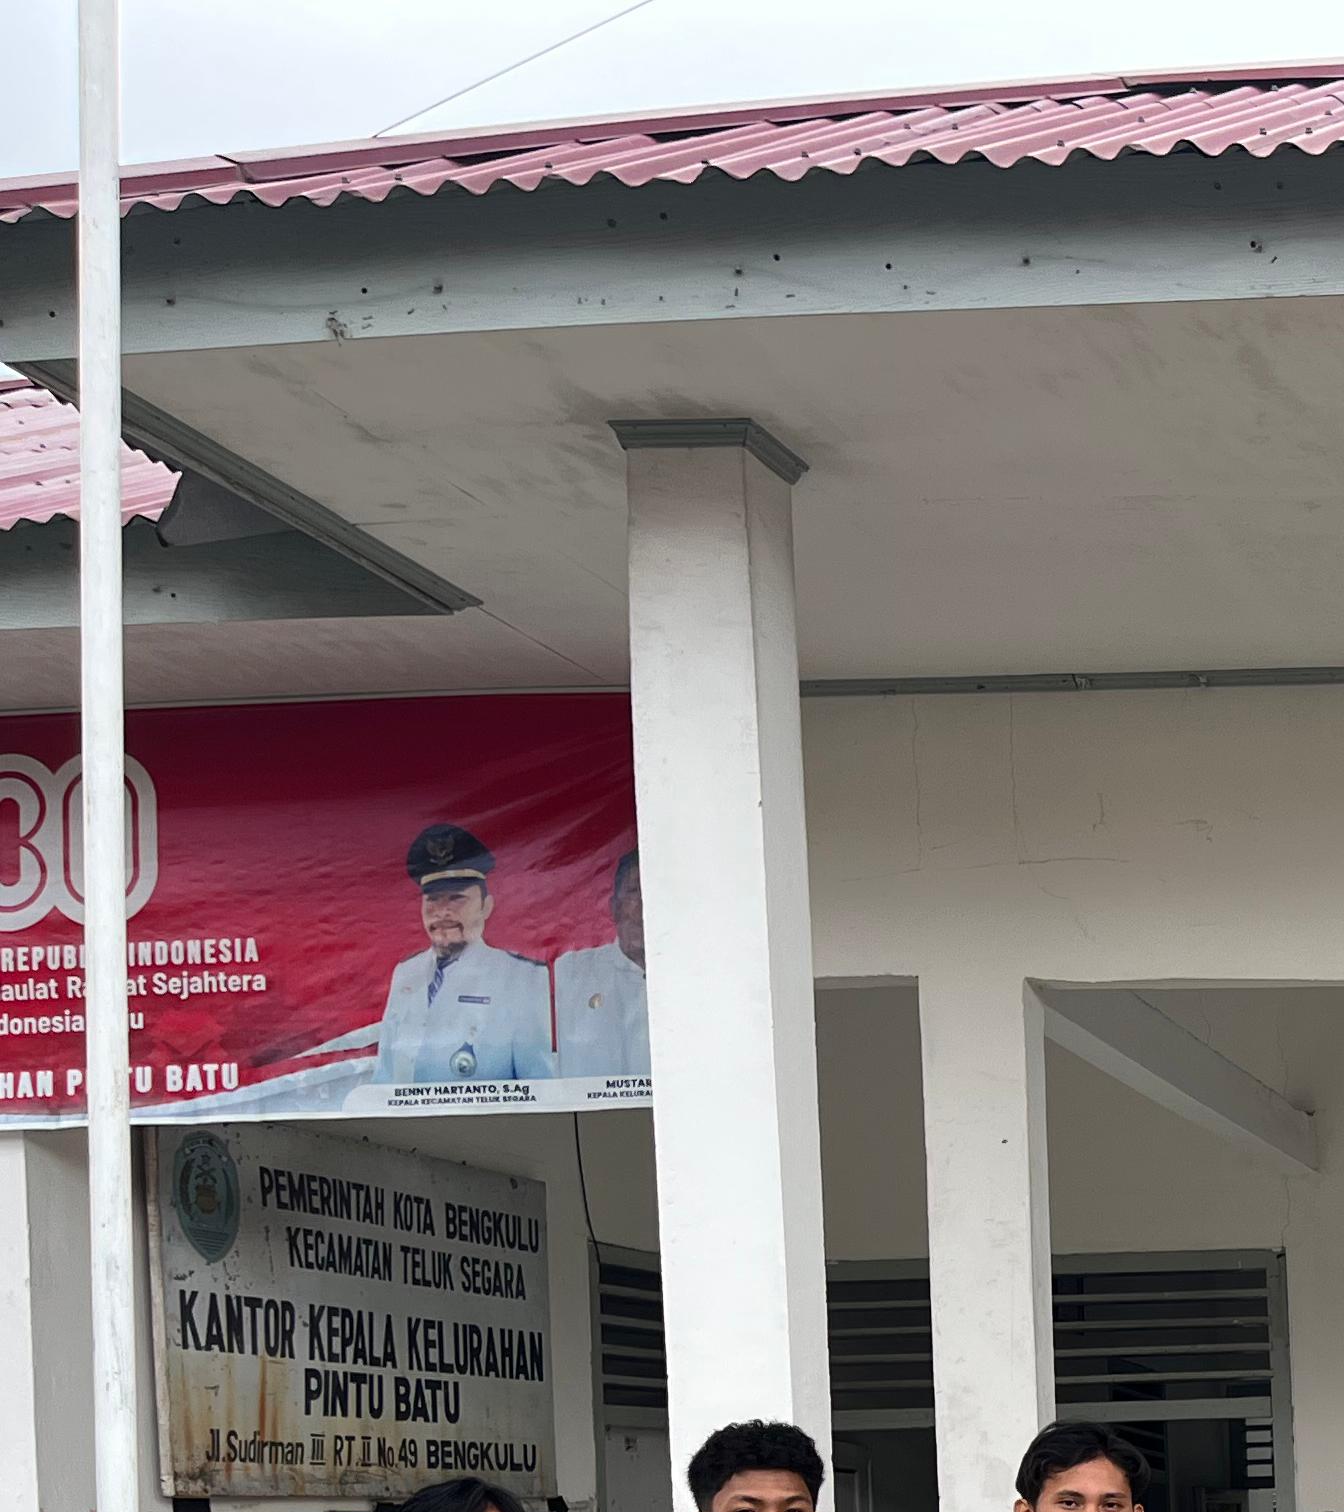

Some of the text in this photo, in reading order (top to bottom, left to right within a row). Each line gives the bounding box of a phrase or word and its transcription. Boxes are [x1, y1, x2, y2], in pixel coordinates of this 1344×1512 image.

[128, 937, 260, 967] INDONESIA
[152, 970, 267, 1000] Sejahtera
[165, 1062, 240, 1093] BATU
[394, 1087, 431, 1098] BENNY
[259, 1166, 540, 1253] PEMERINTAH KOTA BENGKULU
[286, 1225, 527, 1300] KECAMATAN TELUK SEGARA
[179, 1288, 544, 1382] KANTOR KEPALA KELURAHAN
[304, 1367, 461, 1424] PINTU BATU
[310, 1432, 326, 1466] III
[426, 1438, 537, 1472] BENGKULU
